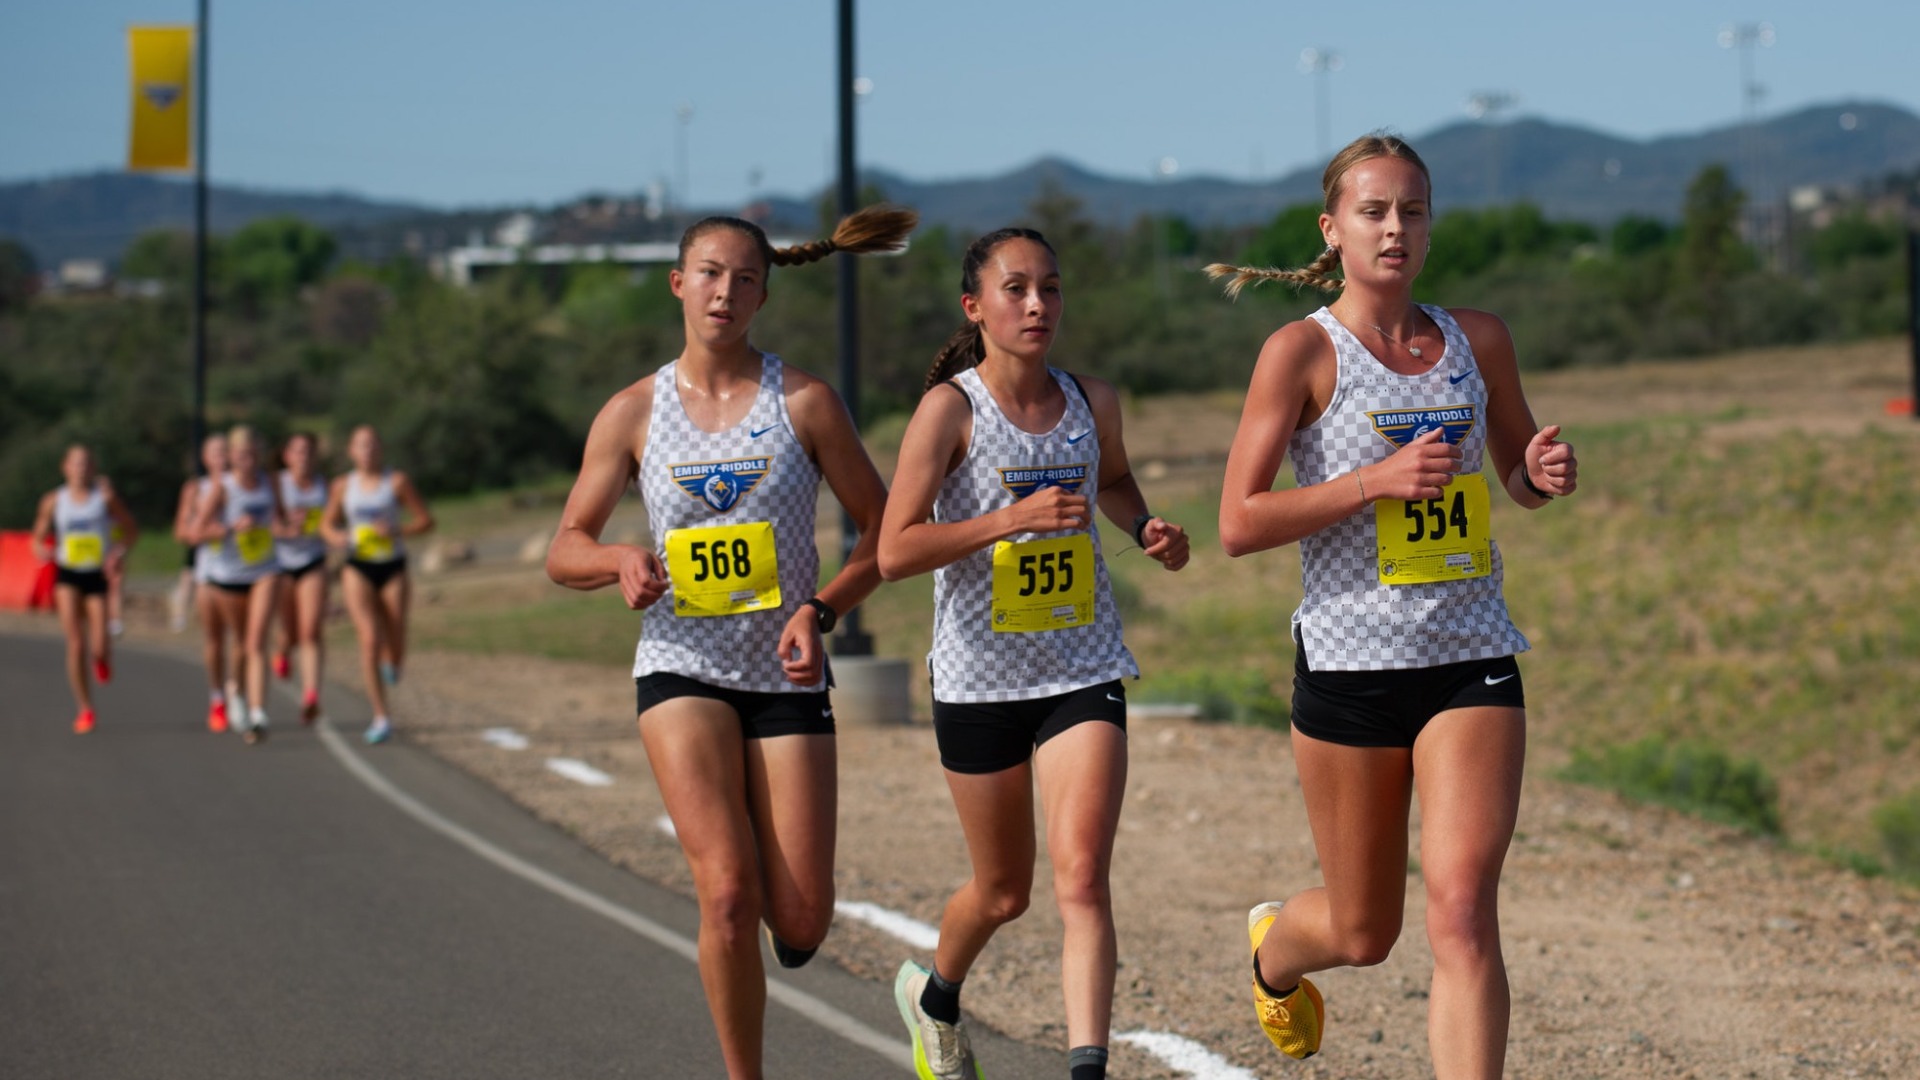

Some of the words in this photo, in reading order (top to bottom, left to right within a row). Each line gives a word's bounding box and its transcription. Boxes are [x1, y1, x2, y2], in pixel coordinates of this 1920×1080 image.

[1376, 409, 1473, 426] EMBRY-RIDDLE
[674, 460, 766, 477] EMBRY-RIDDLE
[1006, 467, 1085, 482] EMBRY-RIDDLE
[1404, 491, 1468, 543] 554
[690, 538, 751, 582] 568
[1019, 550, 1074, 597] 555
